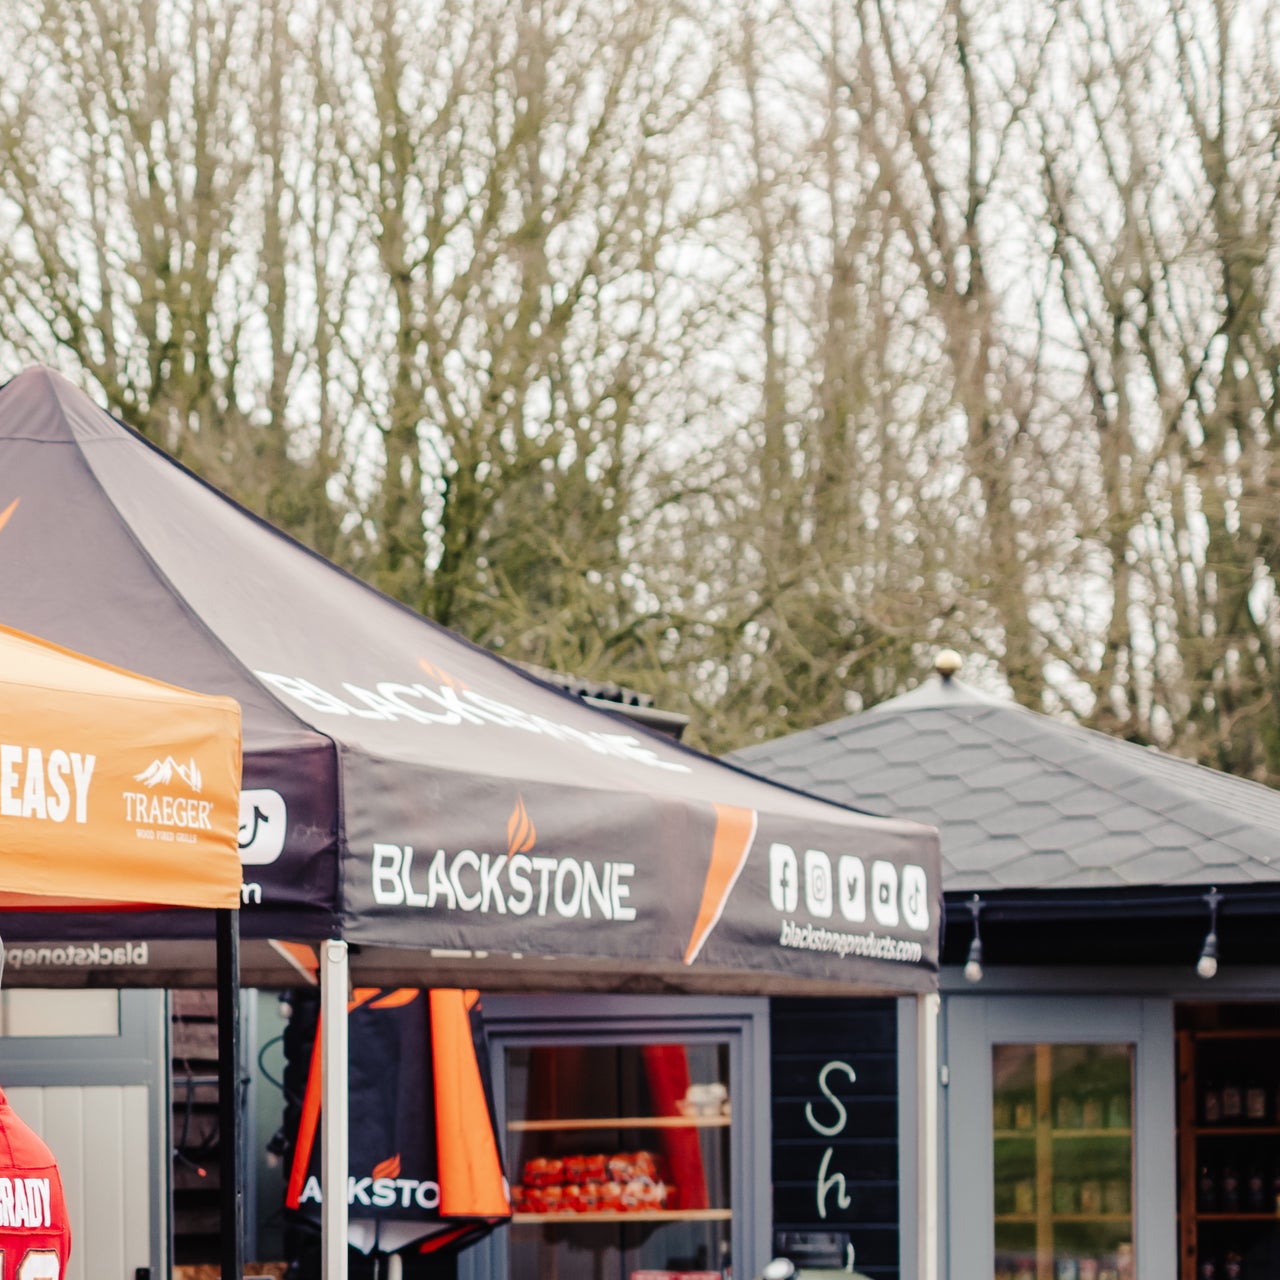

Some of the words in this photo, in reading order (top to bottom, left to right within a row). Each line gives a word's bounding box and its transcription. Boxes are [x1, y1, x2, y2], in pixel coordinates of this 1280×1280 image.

[0, 743, 96, 824] EASY
[122, 791, 212, 831] TRAEGER
[372, 843, 637, 922] BLACKSTONE
[780, 919, 923, 963] blackstoneproducts.com
